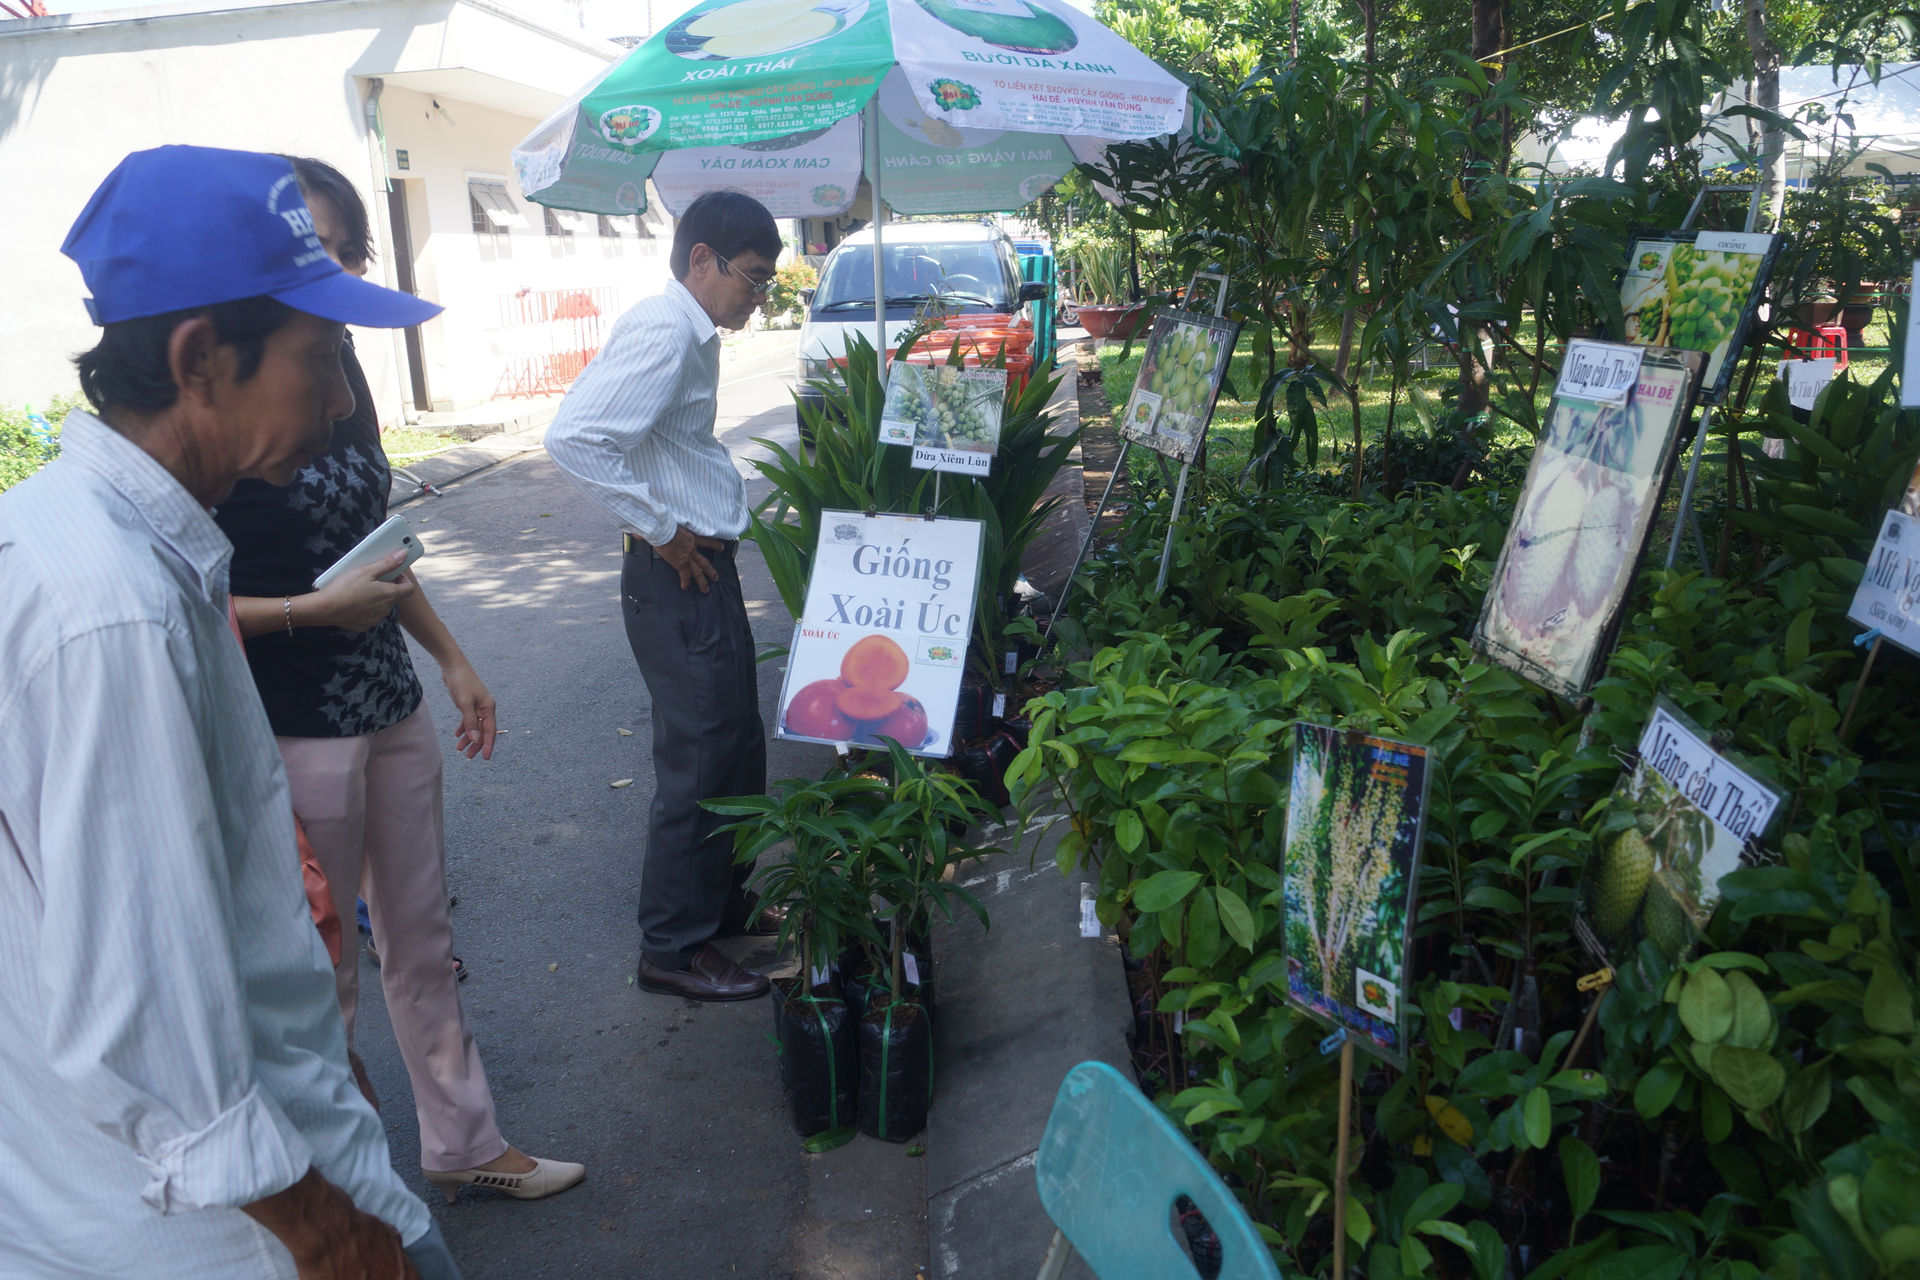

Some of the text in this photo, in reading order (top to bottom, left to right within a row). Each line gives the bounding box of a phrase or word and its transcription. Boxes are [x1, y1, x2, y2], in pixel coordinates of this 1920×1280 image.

[681, 57, 797, 82] XOÀI THÁI
[1024, 57, 1056, 69] DA
[1058, 60, 1118, 75] XANH
[1131, 92, 1148, 102] HOA
[1637, 383, 1658, 398] HAI
[915, 450, 936, 462] Dừa
[939, 453, 965, 465] Xiêm
[853, 538, 953, 591] Giống
[1868, 546, 1900, 590] Mít
[826, 593, 960, 636] Xoài Úc
[802, 628, 840, 640] XOÀI ÚC
